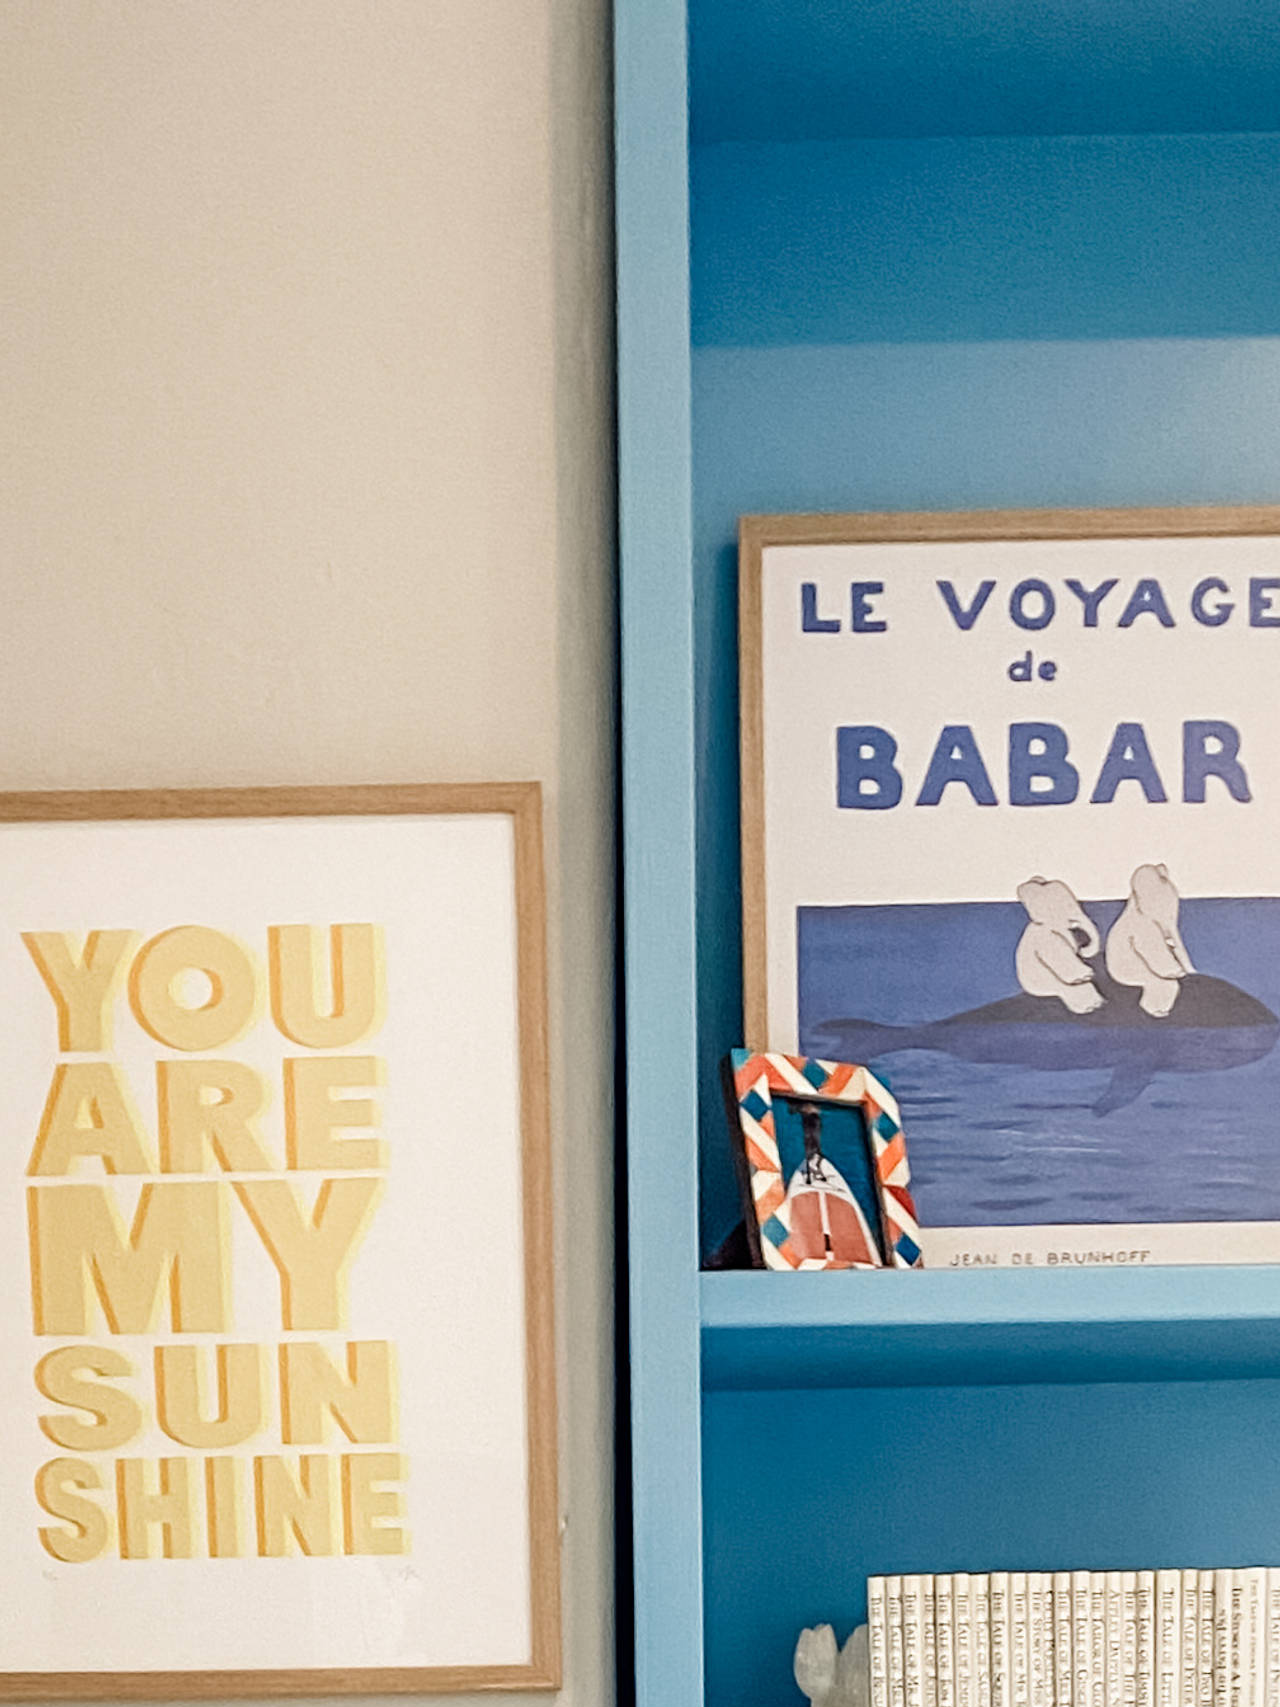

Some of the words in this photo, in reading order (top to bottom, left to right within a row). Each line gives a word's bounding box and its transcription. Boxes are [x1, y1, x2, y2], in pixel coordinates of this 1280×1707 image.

[801, 580, 888, 633] LE
[1007, 650, 1057, 682] de
[836, 720, 1252, 811] BABAR
[21, 923, 385, 1052] YOU
[25, 1055, 388, 1177] ARE
[25, 1177, 384, 1337] MY
[949, 1251, 998, 1267] JEAN
[1012, 1251, 1040, 1266] DE
[1046, 1249, 1152, 1266] BRUNHOFF
[34, 1340, 400, 1450] SUN
[35, 1453, 411, 1563] SHINE
